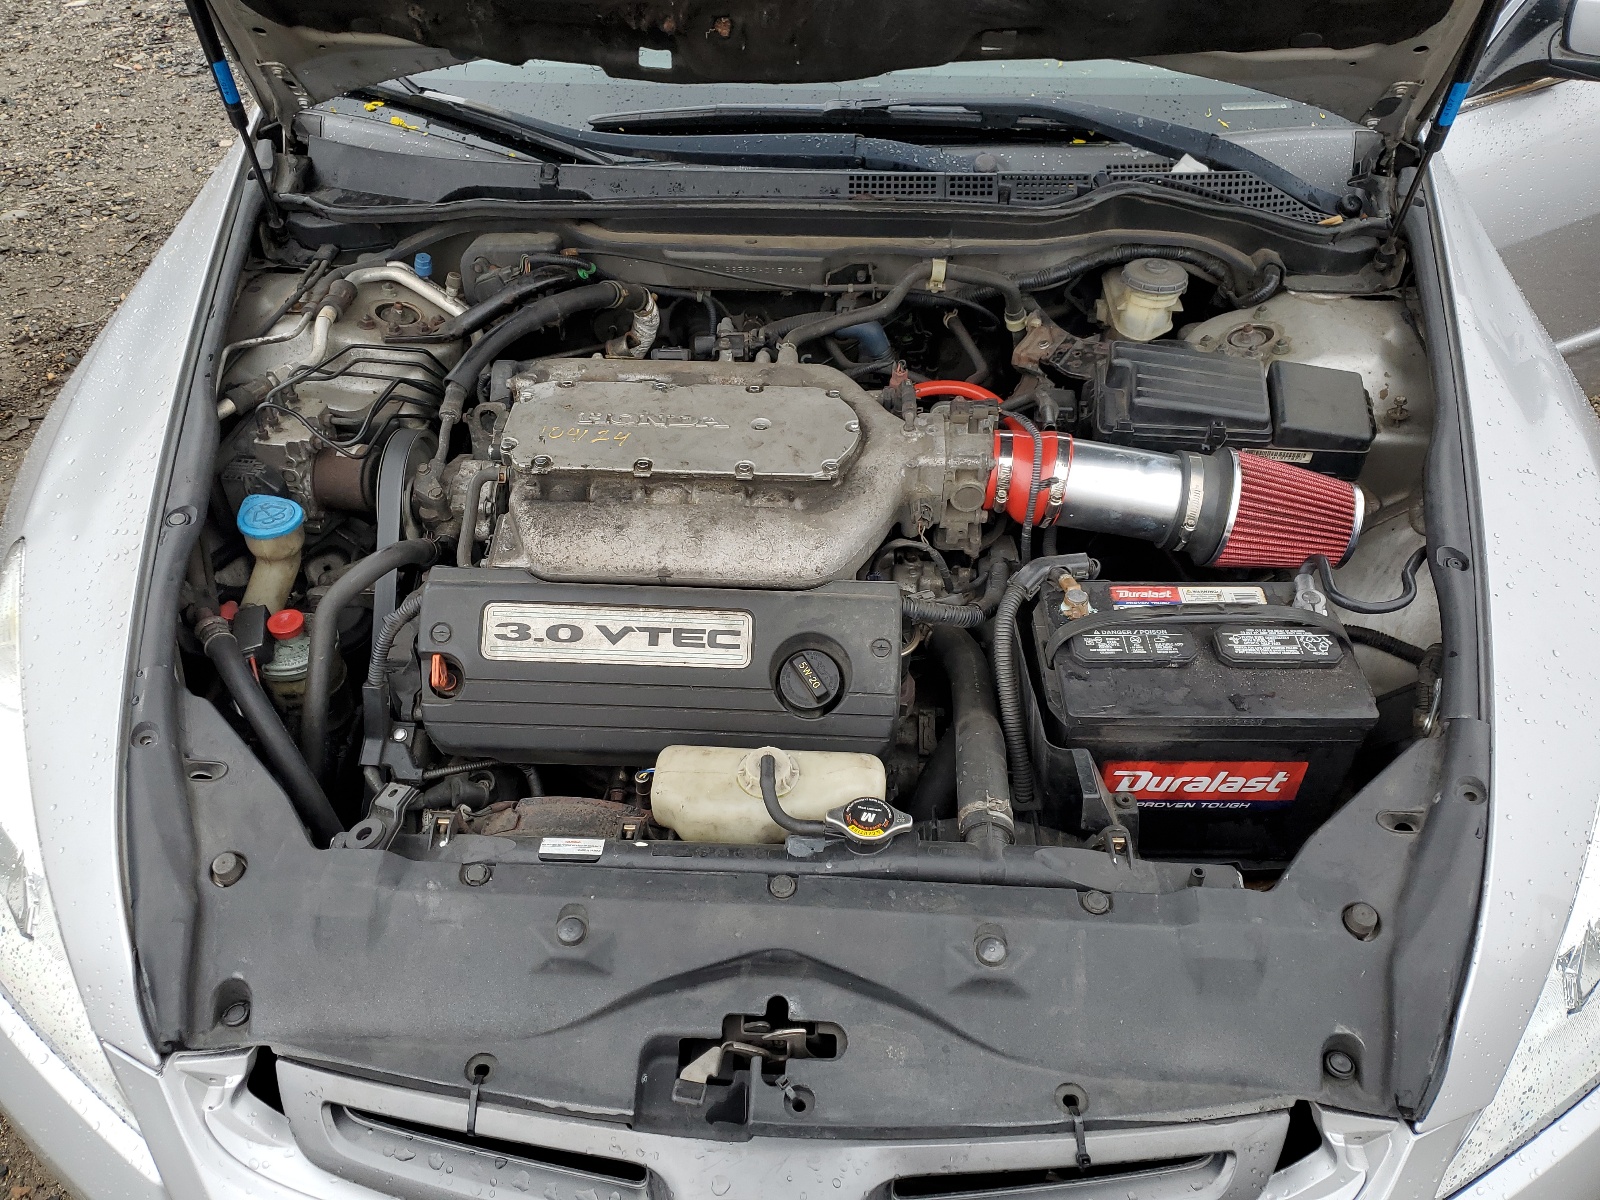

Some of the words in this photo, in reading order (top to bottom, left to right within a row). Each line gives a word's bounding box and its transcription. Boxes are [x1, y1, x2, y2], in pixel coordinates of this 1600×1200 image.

[577, 412, 730, 428] HONDA
[1116, 589, 1172, 599] Duralast
[493, 621, 584, 643] 3.0
[595, 624, 742, 649] VTEC
[798, 661, 821, 689] 5W-20
[1113, 770, 1290, 793] Duralast
[861, 812, 876, 823] M
